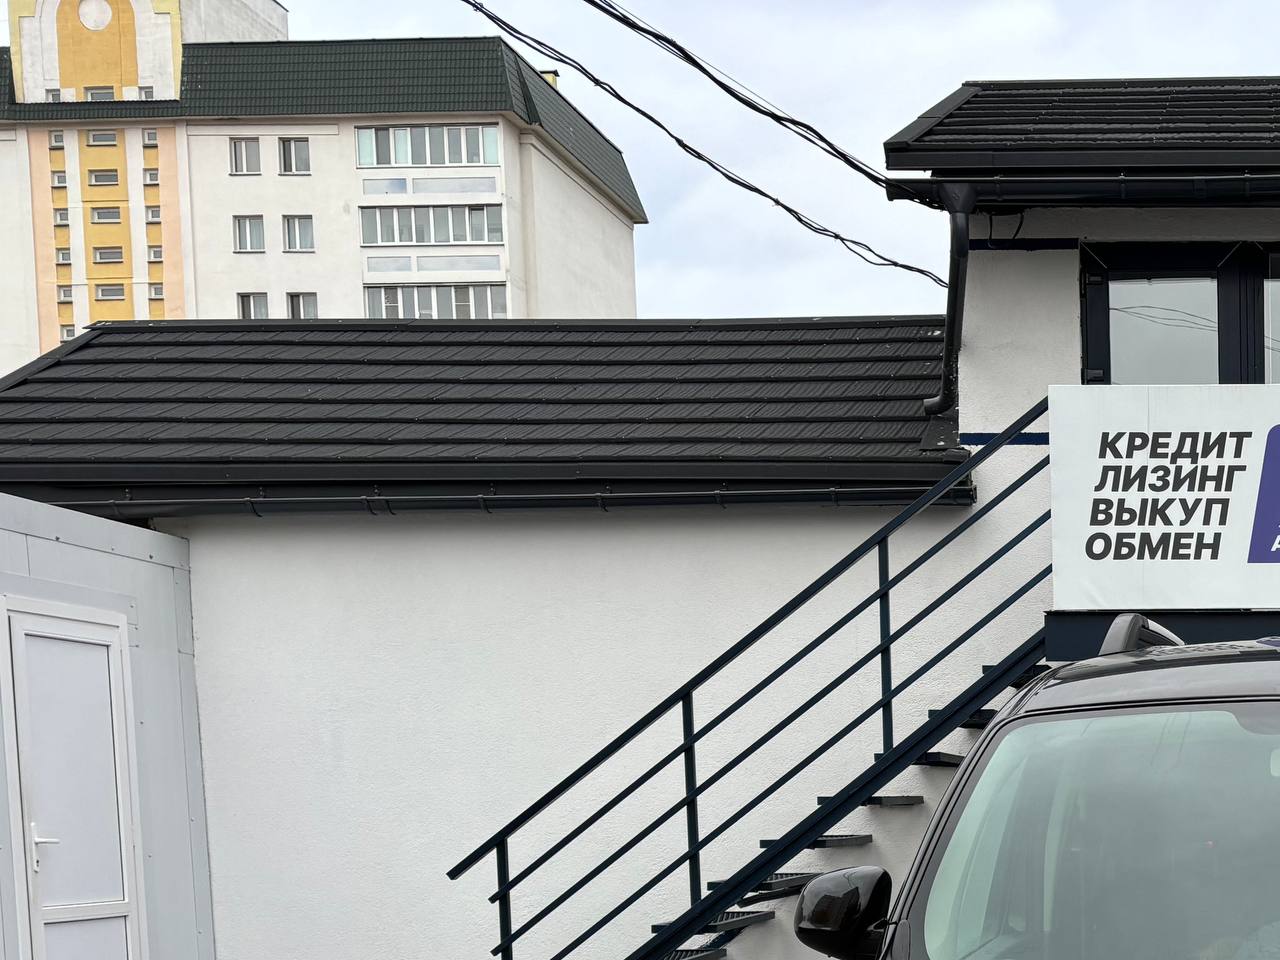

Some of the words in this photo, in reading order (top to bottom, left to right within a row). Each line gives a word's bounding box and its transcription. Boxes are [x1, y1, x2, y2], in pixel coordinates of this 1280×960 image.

[1098, 431, 1253, 465] КРЕДИТ
[1093, 465, 1247, 492] ЛИЗИНГ
[1089, 498, 1230, 527] ВЫКУП
[1085, 532, 1222, 561] ОБМЕН
